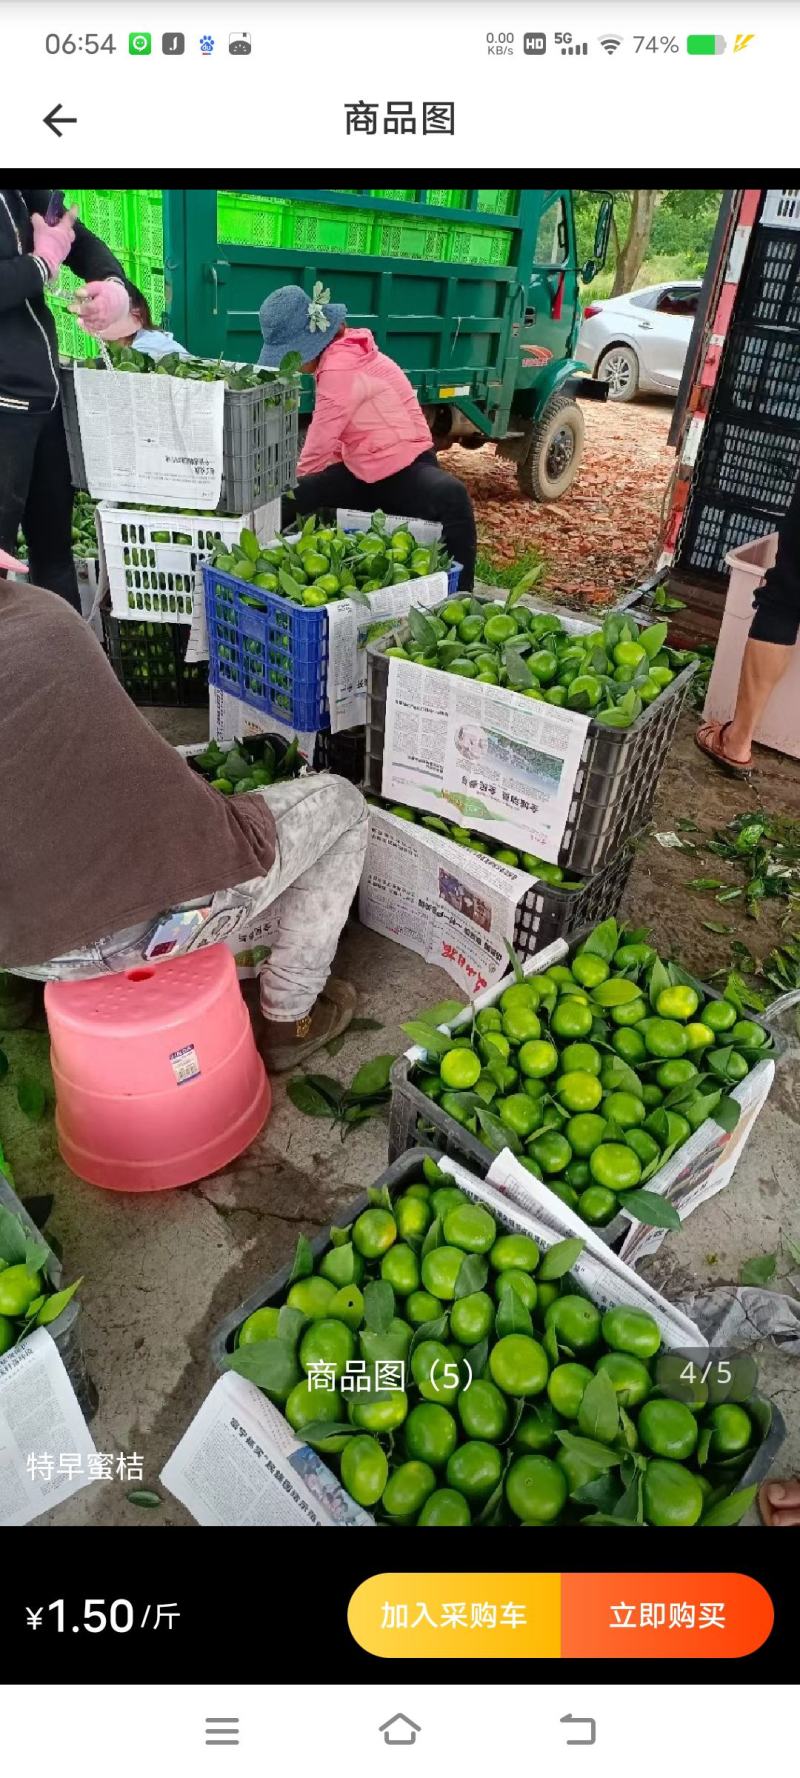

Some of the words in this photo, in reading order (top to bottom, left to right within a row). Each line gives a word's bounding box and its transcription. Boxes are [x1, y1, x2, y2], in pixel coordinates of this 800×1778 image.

[45, 33, 117, 55] 06:54
[486, 32, 514, 44] 0.00
[526, 38, 544, 50] HD
[554, 32, 573, 44] 5G
[633, 35, 679, 54] 74%
[487, 46, 514, 55] KB/s
[343, 99, 457, 137] 商品图
[380, 1601, 528, 1630] 加入采购车
[609, 1601, 726, 1629] 立即购买
